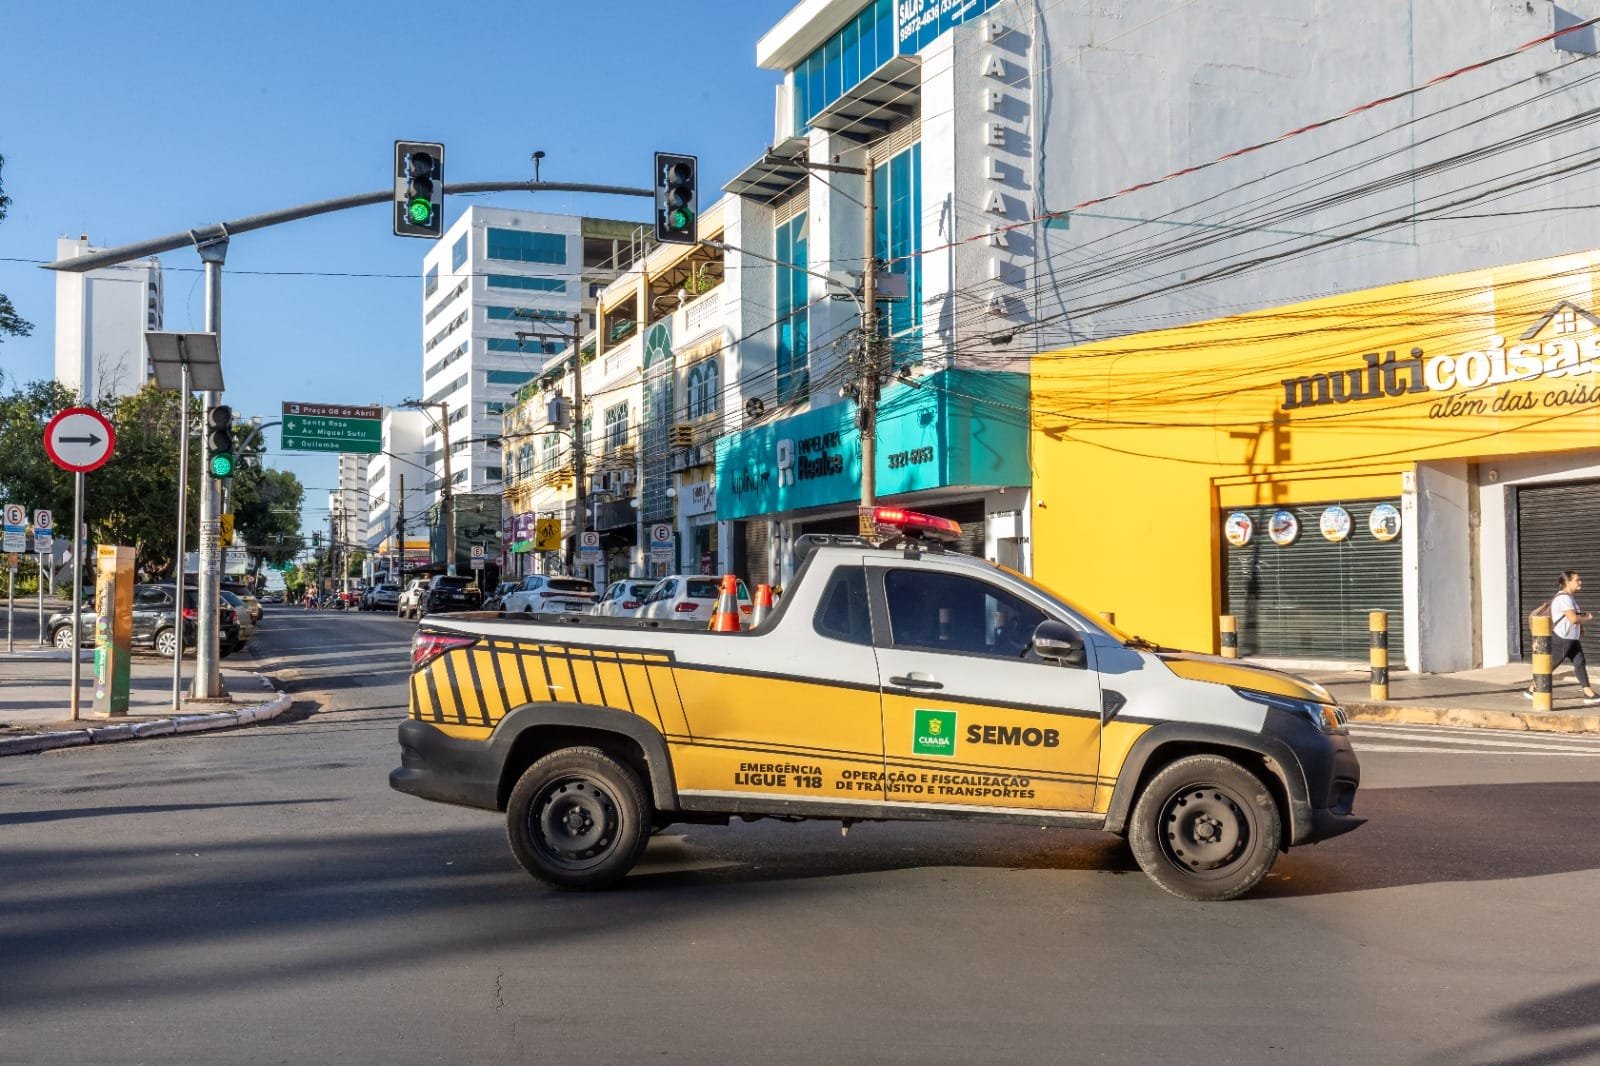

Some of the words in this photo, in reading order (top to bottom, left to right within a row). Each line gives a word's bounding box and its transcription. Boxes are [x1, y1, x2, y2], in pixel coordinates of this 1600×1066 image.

[983, 18, 1008, 316] PAPELARIA
[1429, 393, 1487, 419] além
[1492, 389, 1538, 413] das
[303, 407, 326, 415] Praça
[355, 409, 375, 417] Abril
[302, 419, 326, 427] Santa
[328, 420, 347, 428] Rosa
[317, 429, 344, 437] Miguel
[347, 430, 367, 438] Sutil
[41, 514, 47, 525] E
[659, 529, 665, 539] E
[918, 736, 951, 746] CUIABÁ
[966, 723, 1060, 748] SEMOB
[740, 762, 823, 776] EMERGÊNCIA
[734, 772, 787, 787] LIGUE
[793, 775, 823, 790] 118
[841, 769, 917, 786] OPERAÇÃO
[920, 773, 928, 783] E
[931, 774, 1031, 790] FISCALIZAÇÃO
[835, 780, 853, 791] DE
[927, 785, 935, 795] E
[938, 785, 1036, 800] TRANSPORTES
